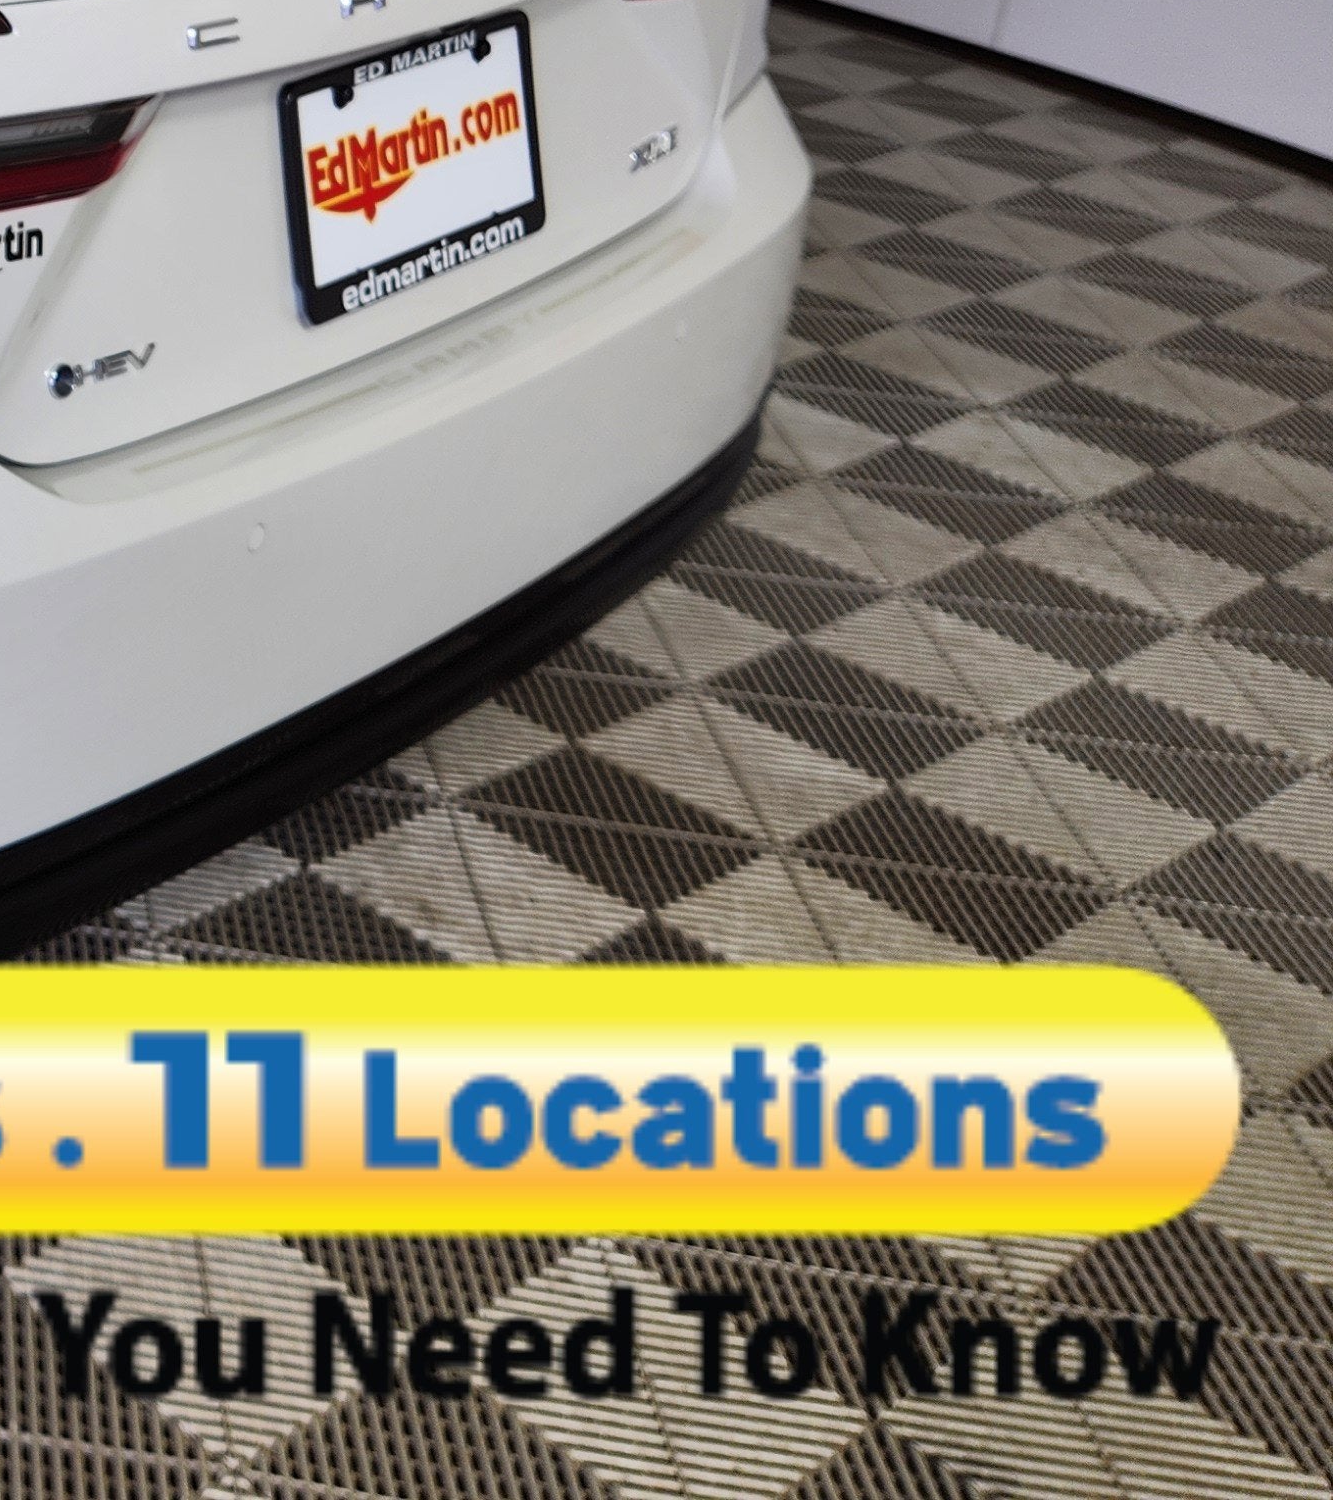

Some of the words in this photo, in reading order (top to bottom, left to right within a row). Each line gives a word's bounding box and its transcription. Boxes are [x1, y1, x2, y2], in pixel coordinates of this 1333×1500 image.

[353, 63, 384, 86] ED
[391, 30, 477, 75] MARTIN
[341, 215, 525, 312] edmartin.com
[72, 342, 156, 387] HEV
